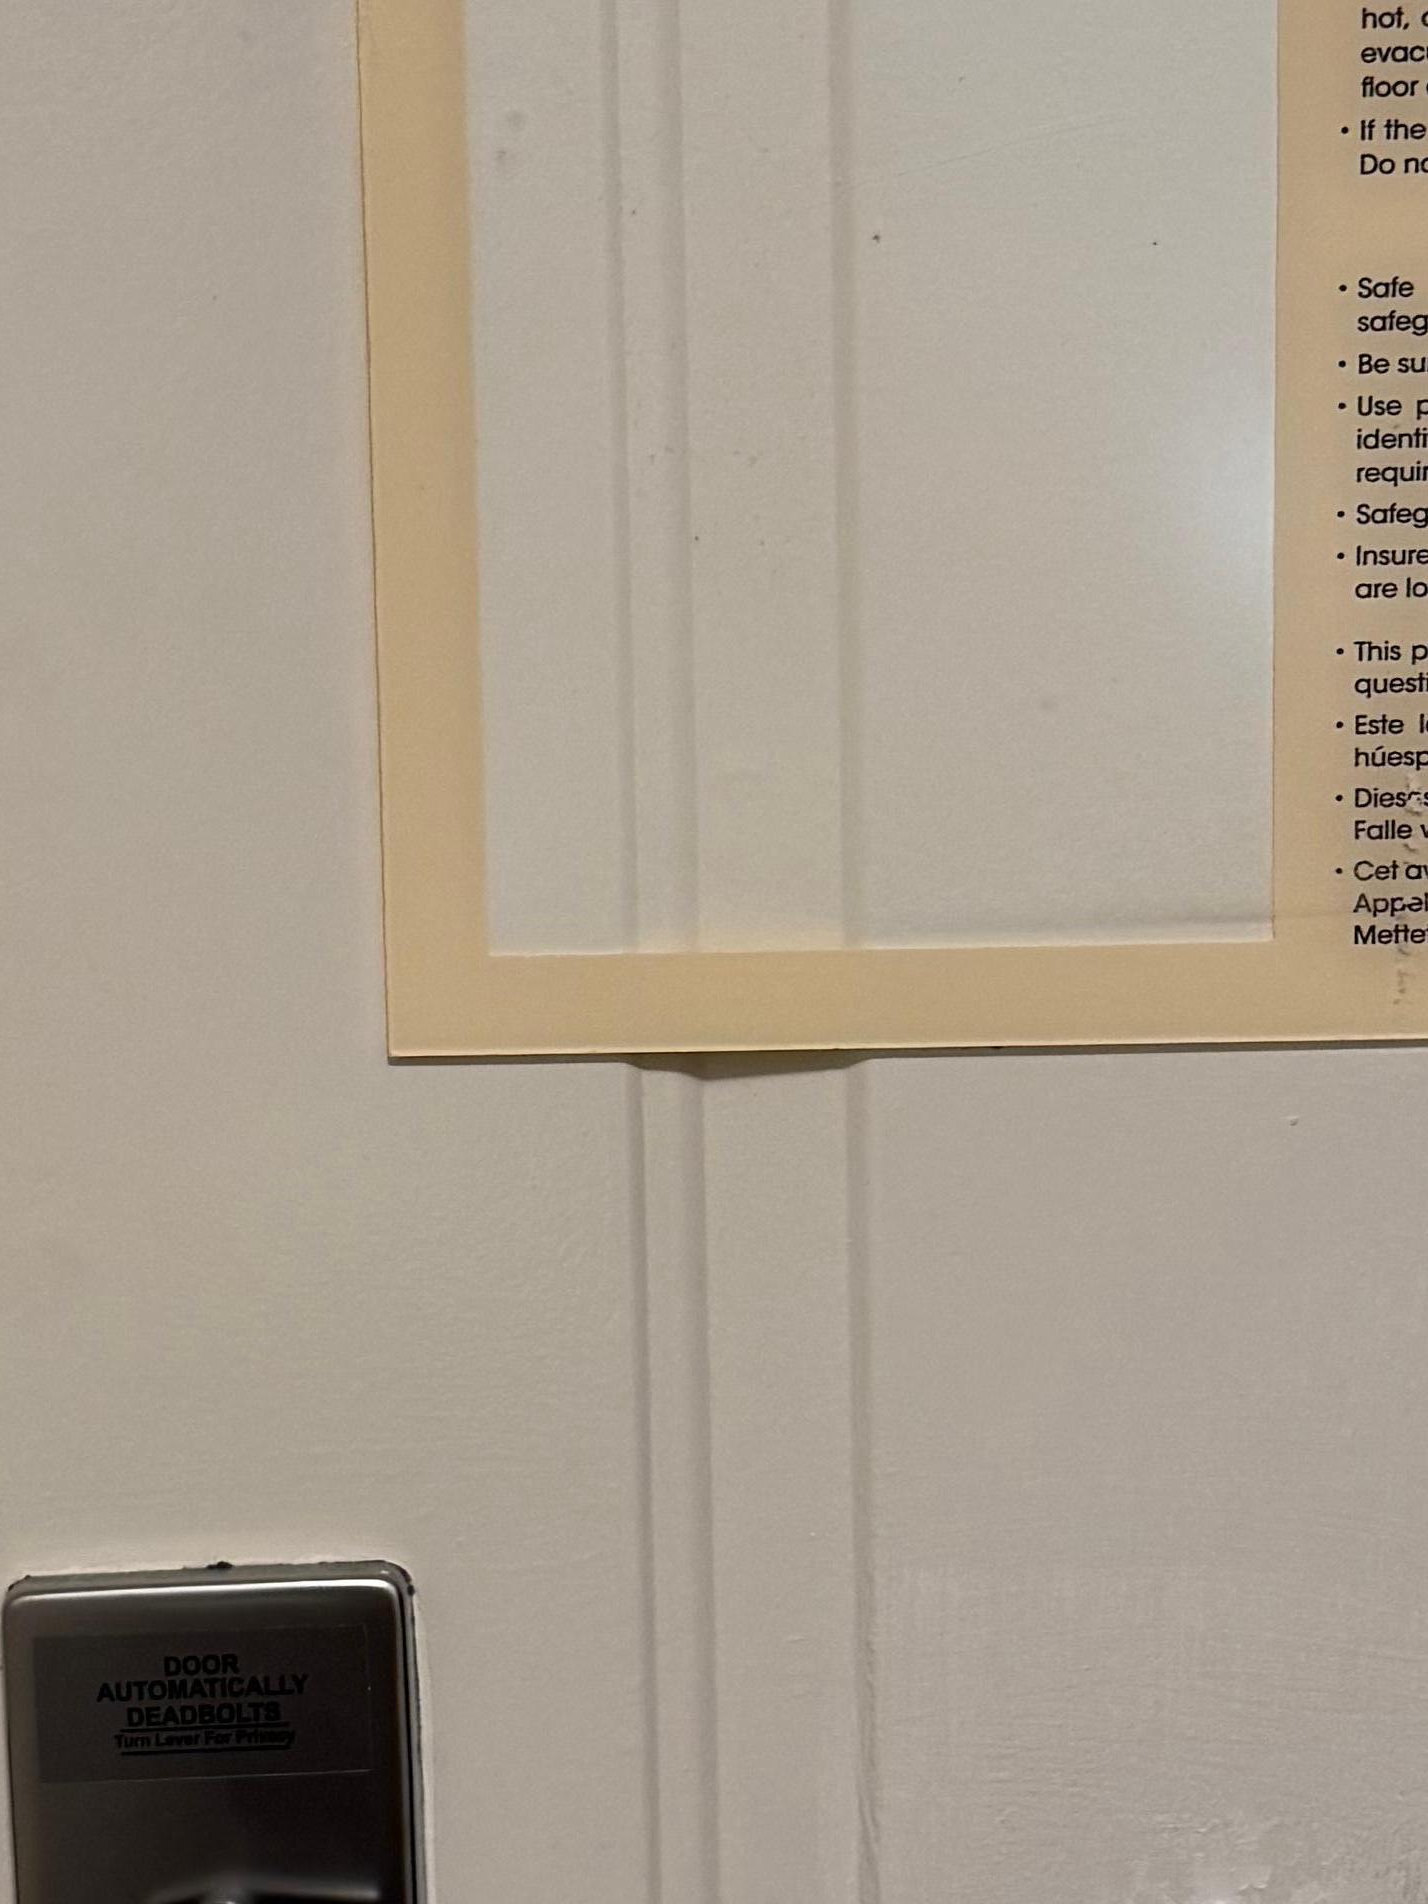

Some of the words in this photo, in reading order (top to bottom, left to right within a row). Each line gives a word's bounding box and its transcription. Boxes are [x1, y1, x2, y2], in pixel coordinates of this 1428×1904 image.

[1362, 6, 1410, 30] hot,
[1361, 76, 1419, 98] floor
[1360, 153, 1396, 175] Do
[1357, 395, 1402, 416] Use
[1355, 582, 1398, 599] are
[1355, 714, 1404, 735] Este
[1353, 819, 1413, 840] Falle
[164, 1653, 239, 1676] DOOR
[96, 1673, 309, 1703] AUTOMATICALLY
[126, 1701, 282, 1727] DEADBOLTS
[114, 1733, 150, 1748] Turn
[155, 1732, 201, 1747] Lever
[204, 1730, 232, 1745] For
